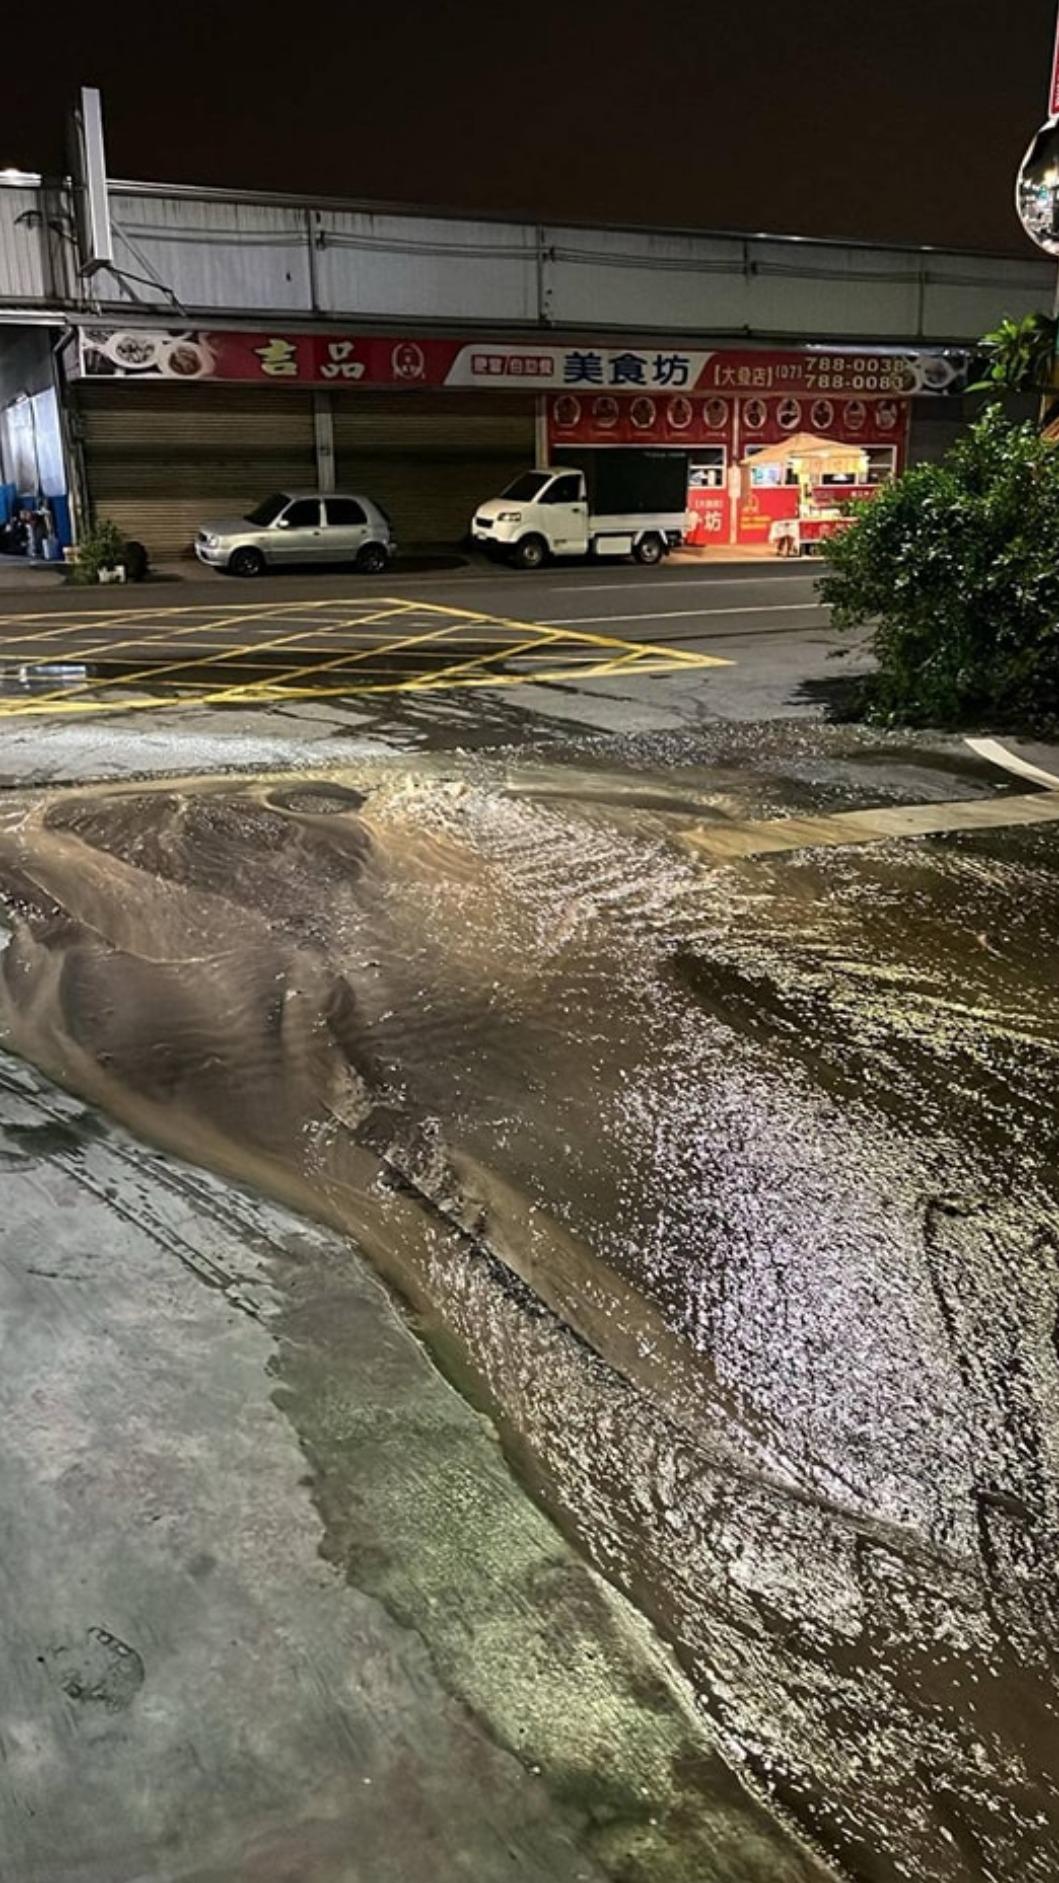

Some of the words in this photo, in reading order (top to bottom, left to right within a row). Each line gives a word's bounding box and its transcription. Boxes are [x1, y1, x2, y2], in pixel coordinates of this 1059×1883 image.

[254, 338, 365, 379] 吉品
[563, 351, 690, 386] 美食坊
